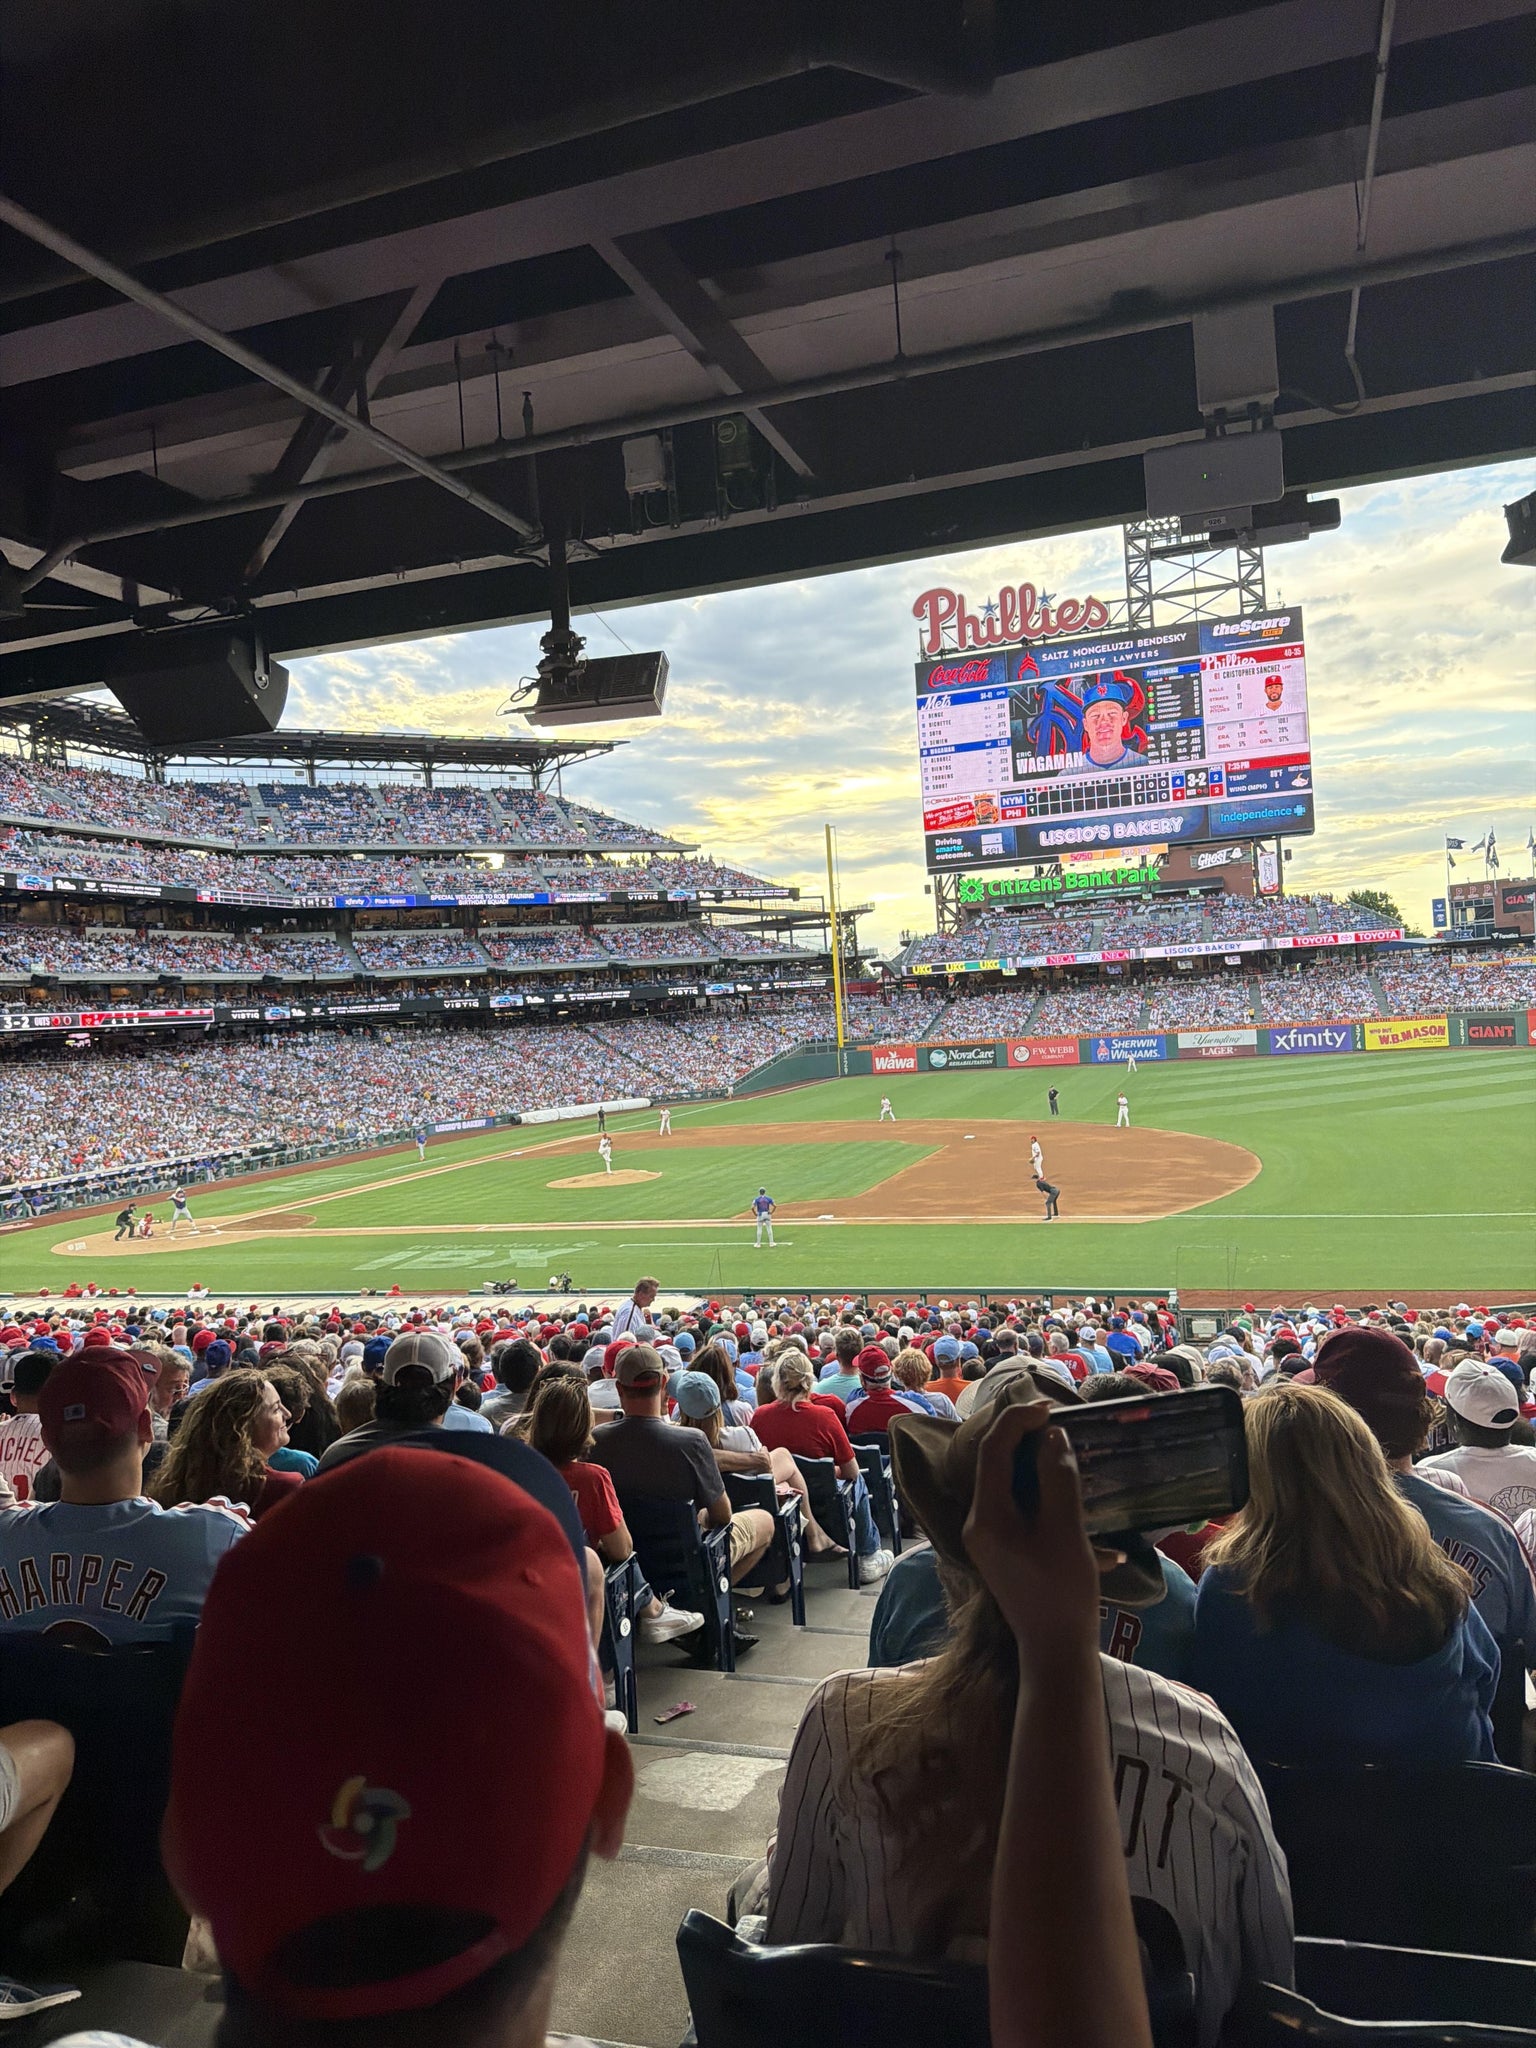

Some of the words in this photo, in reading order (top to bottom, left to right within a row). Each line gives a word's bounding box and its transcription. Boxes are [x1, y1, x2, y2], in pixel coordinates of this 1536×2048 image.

[912, 582, 1110, 656] Phillies
[1211, 616, 1291, 637] theScore
[1041, 650, 1069, 662] SALTZ
[1072, 641, 1134, 657] MONGELUZZI
[1137, 632, 1188, 648] BENDESKY
[1069, 658, 1106, 670] INJURY
[1113, 650, 1160, 664] LAWYERS
[921, 695, 952, 710] Mets
[1016, 751, 1033, 760] ERIC
[1016, 752, 1085, 775] WAGAMAN
[1188, 772, 1208, 788] 3-2
[1002, 796, 1024, 806] NYM
[1028, 795, 1035, 803] 0
[1148, 781, 1155, 789] 0
[1160, 779, 1167, 787] 0
[1005, 809, 1023, 818] PHI
[1161, 792, 1168, 800] 0
[1220, 807, 1292, 822] Independence
[1040, 827, 1111, 846] LISCIO'S
[1112, 817, 1184, 838] BAKERY
[935, 838, 963, 847] Driving
[935, 845, 964, 853] smarter
[935, 852, 975, 860] outcomes.
[1197, 848, 1233, 869] GHOST
[987, 875, 1062, 896] Citizens
[1065, 868, 1114, 890] Bank
[1116, 865, 1161, 885] Park
[1294, 935, 1337, 945] TOYOTA
[1357, 930, 1399, 940] TOYOTA
[1164, 945, 1203, 955] LISCIO'S
[1204, 942, 1241, 953] BAKERY
[912, 964, 932, 974] UKG
[945, 961, 966, 972] UKG
[979, 959, 1000, 970] UKG
[3, 1015, 30, 1029] 3-2
[1469, 1025, 1514, 1038] GIANT
[1111, 1038, 1158, 1049] SHERWIN
[1192, 1033, 1243, 1046] Yuengling
[1275, 1028, 1347, 1051] xfinity
[948, 1049, 995, 1061] NovaCare
[1048, 1046, 1075, 1055] WEBB
[1202, 1046, 1235, 1056] LAGER
[874, 1057, 915, 1071] Wawa
